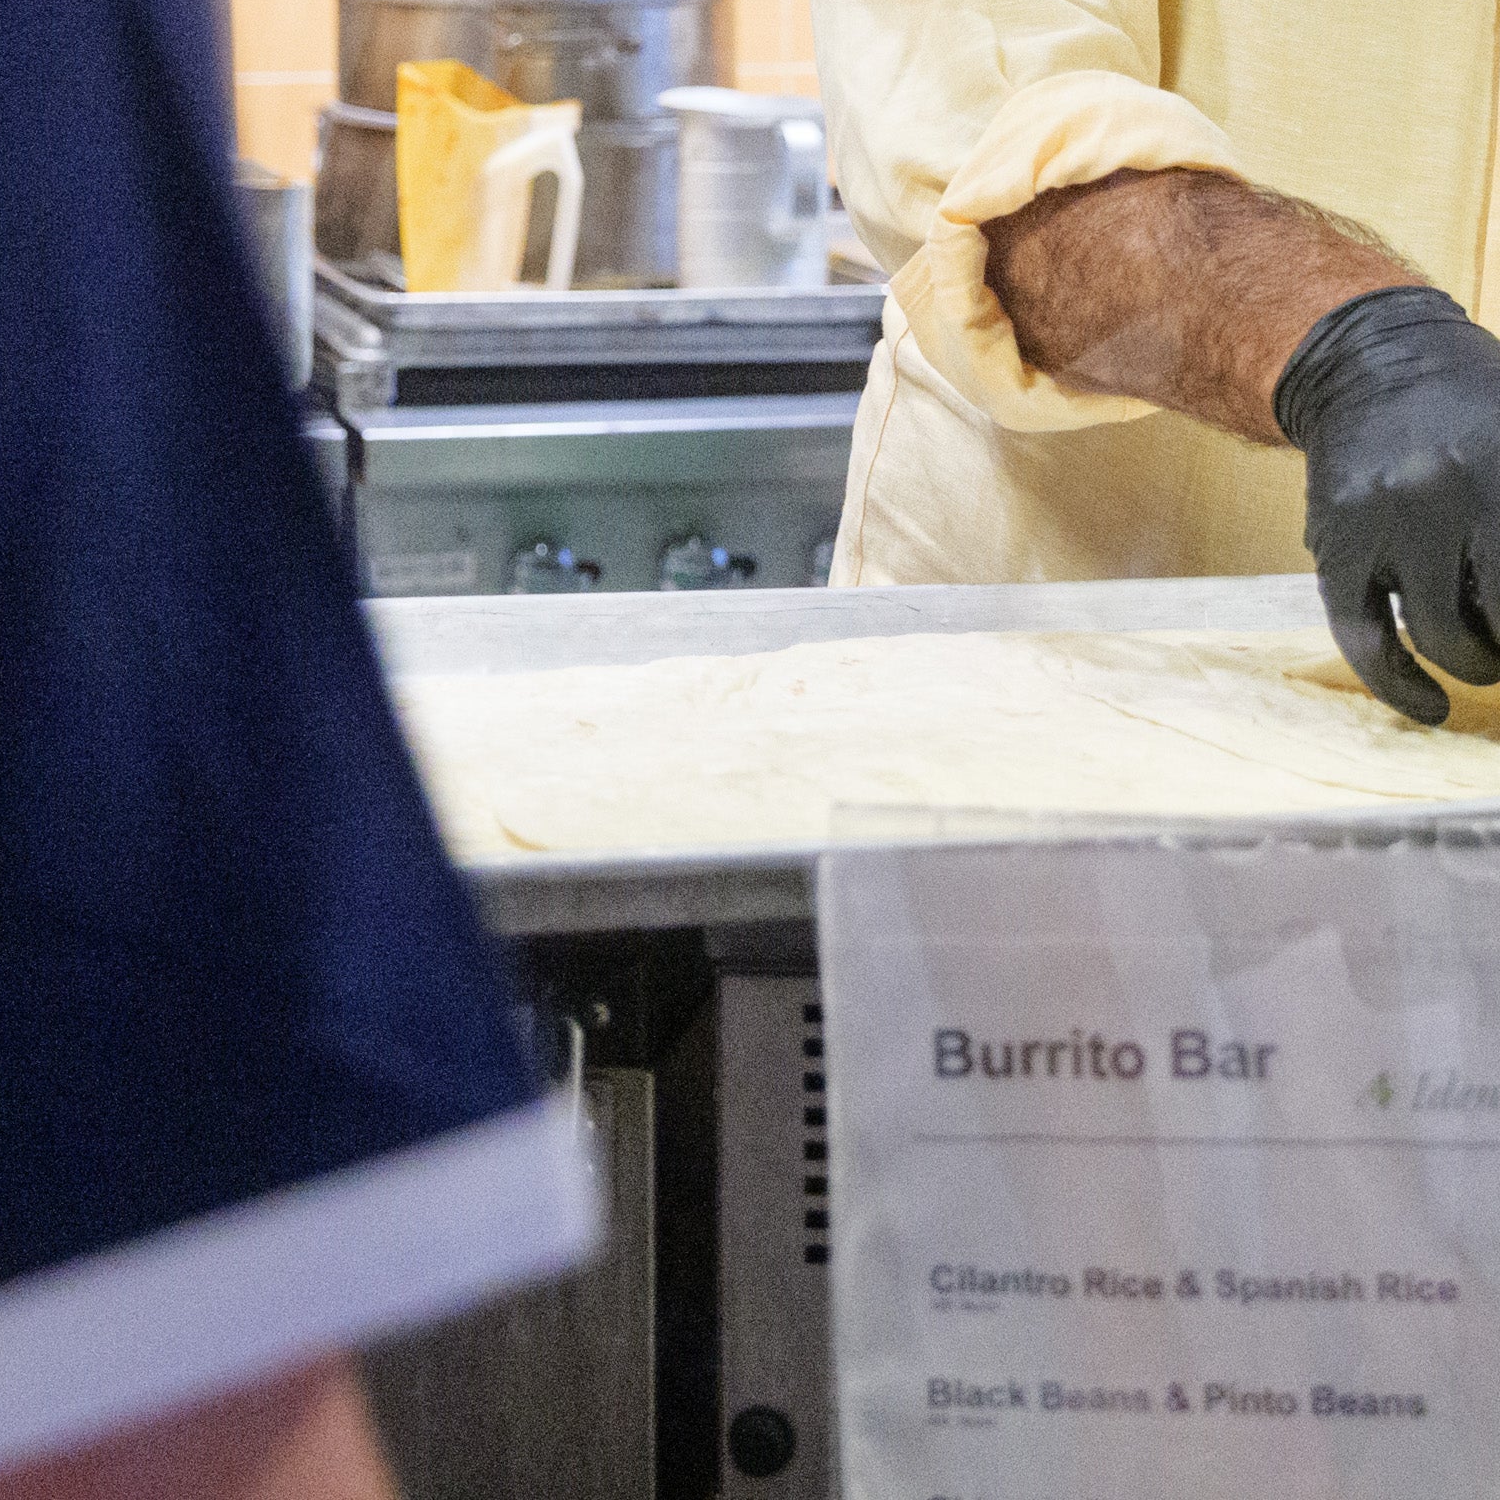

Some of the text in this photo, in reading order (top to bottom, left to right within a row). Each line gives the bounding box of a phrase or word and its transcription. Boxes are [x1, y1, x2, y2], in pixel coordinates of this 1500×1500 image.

[932, 1027, 1276, 1083] Burrito Bar
[928, 1263, 1459, 1308] Cilantro Rice & Spanish Rice
[927, 1377, 1428, 1419] Black Beans & Pinto Beans
